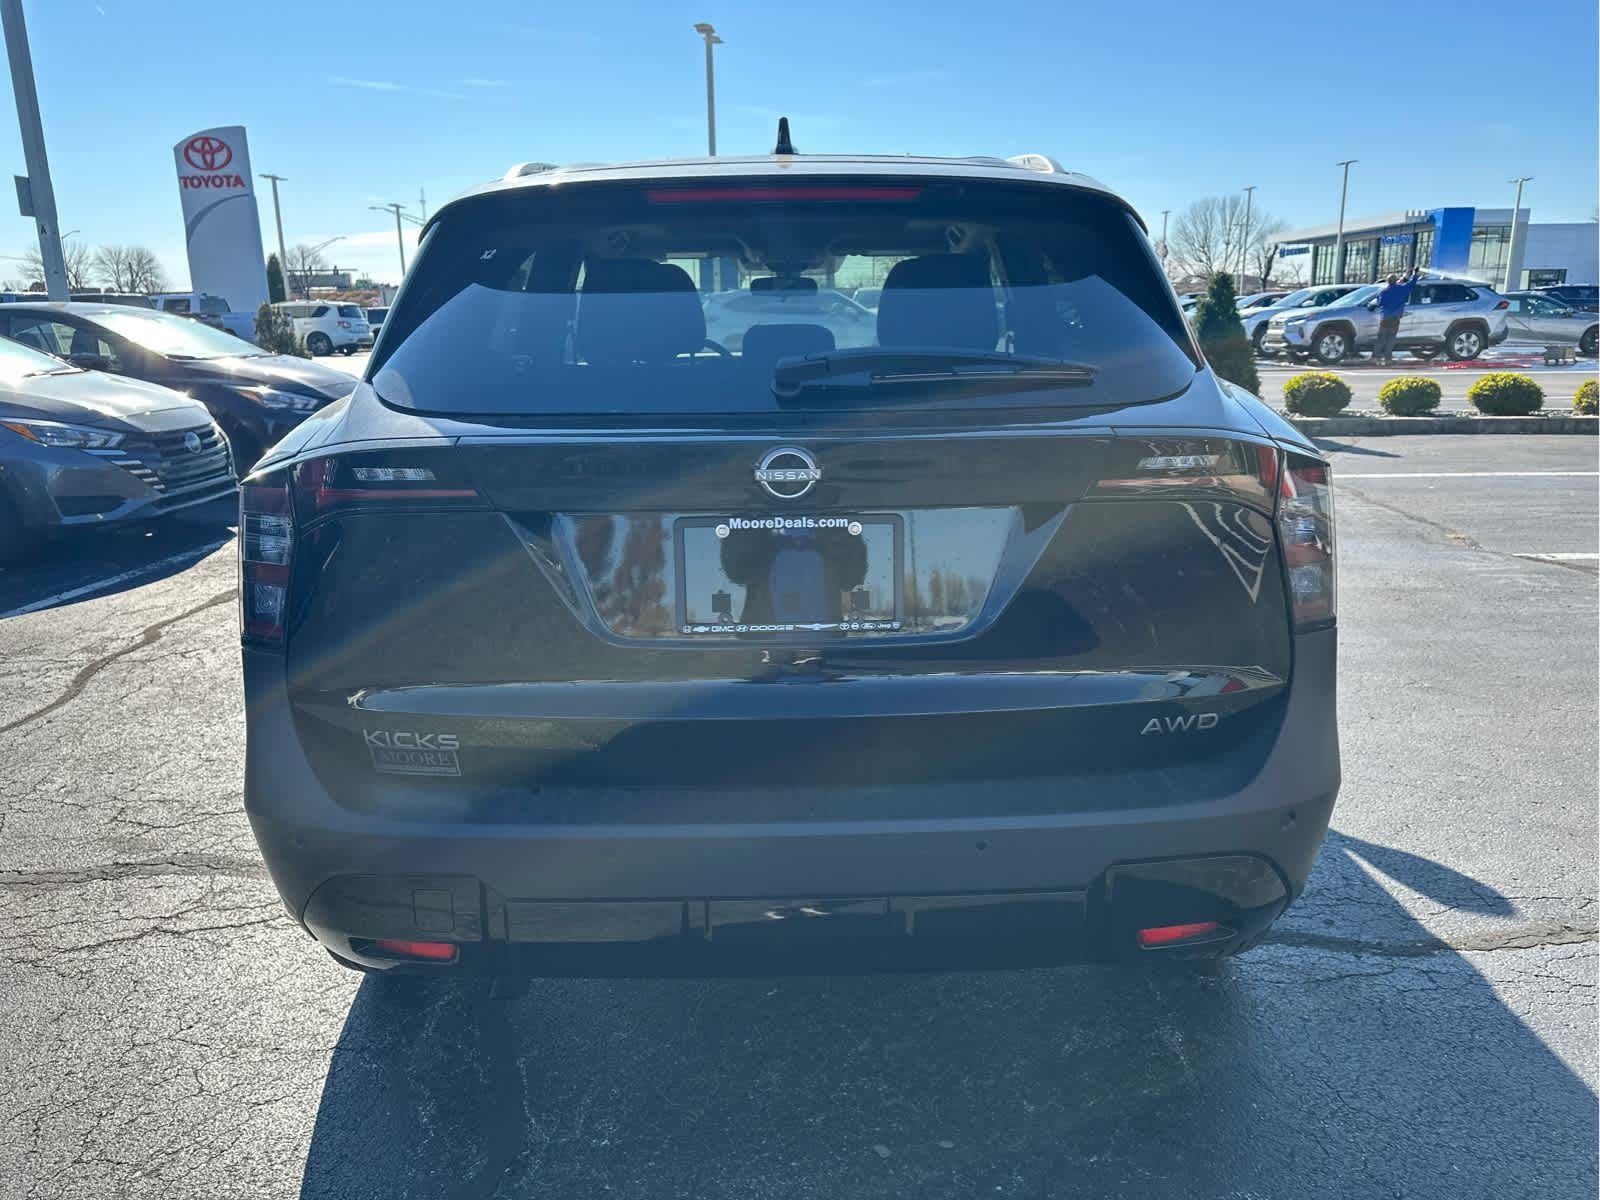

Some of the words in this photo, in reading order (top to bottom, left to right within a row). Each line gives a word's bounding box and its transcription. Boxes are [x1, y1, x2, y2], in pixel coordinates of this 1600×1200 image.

[179, 174, 246, 189] TOYOTA
[755, 470, 821, 481] NISSAN
[729, 516, 849, 529] MooreDeals.com
[711, 625, 735, 633] GMC
[749, 624, 795, 632] DODGE
[1140, 712, 1219, 736] AWD
[362, 728, 461, 750] KICKS
